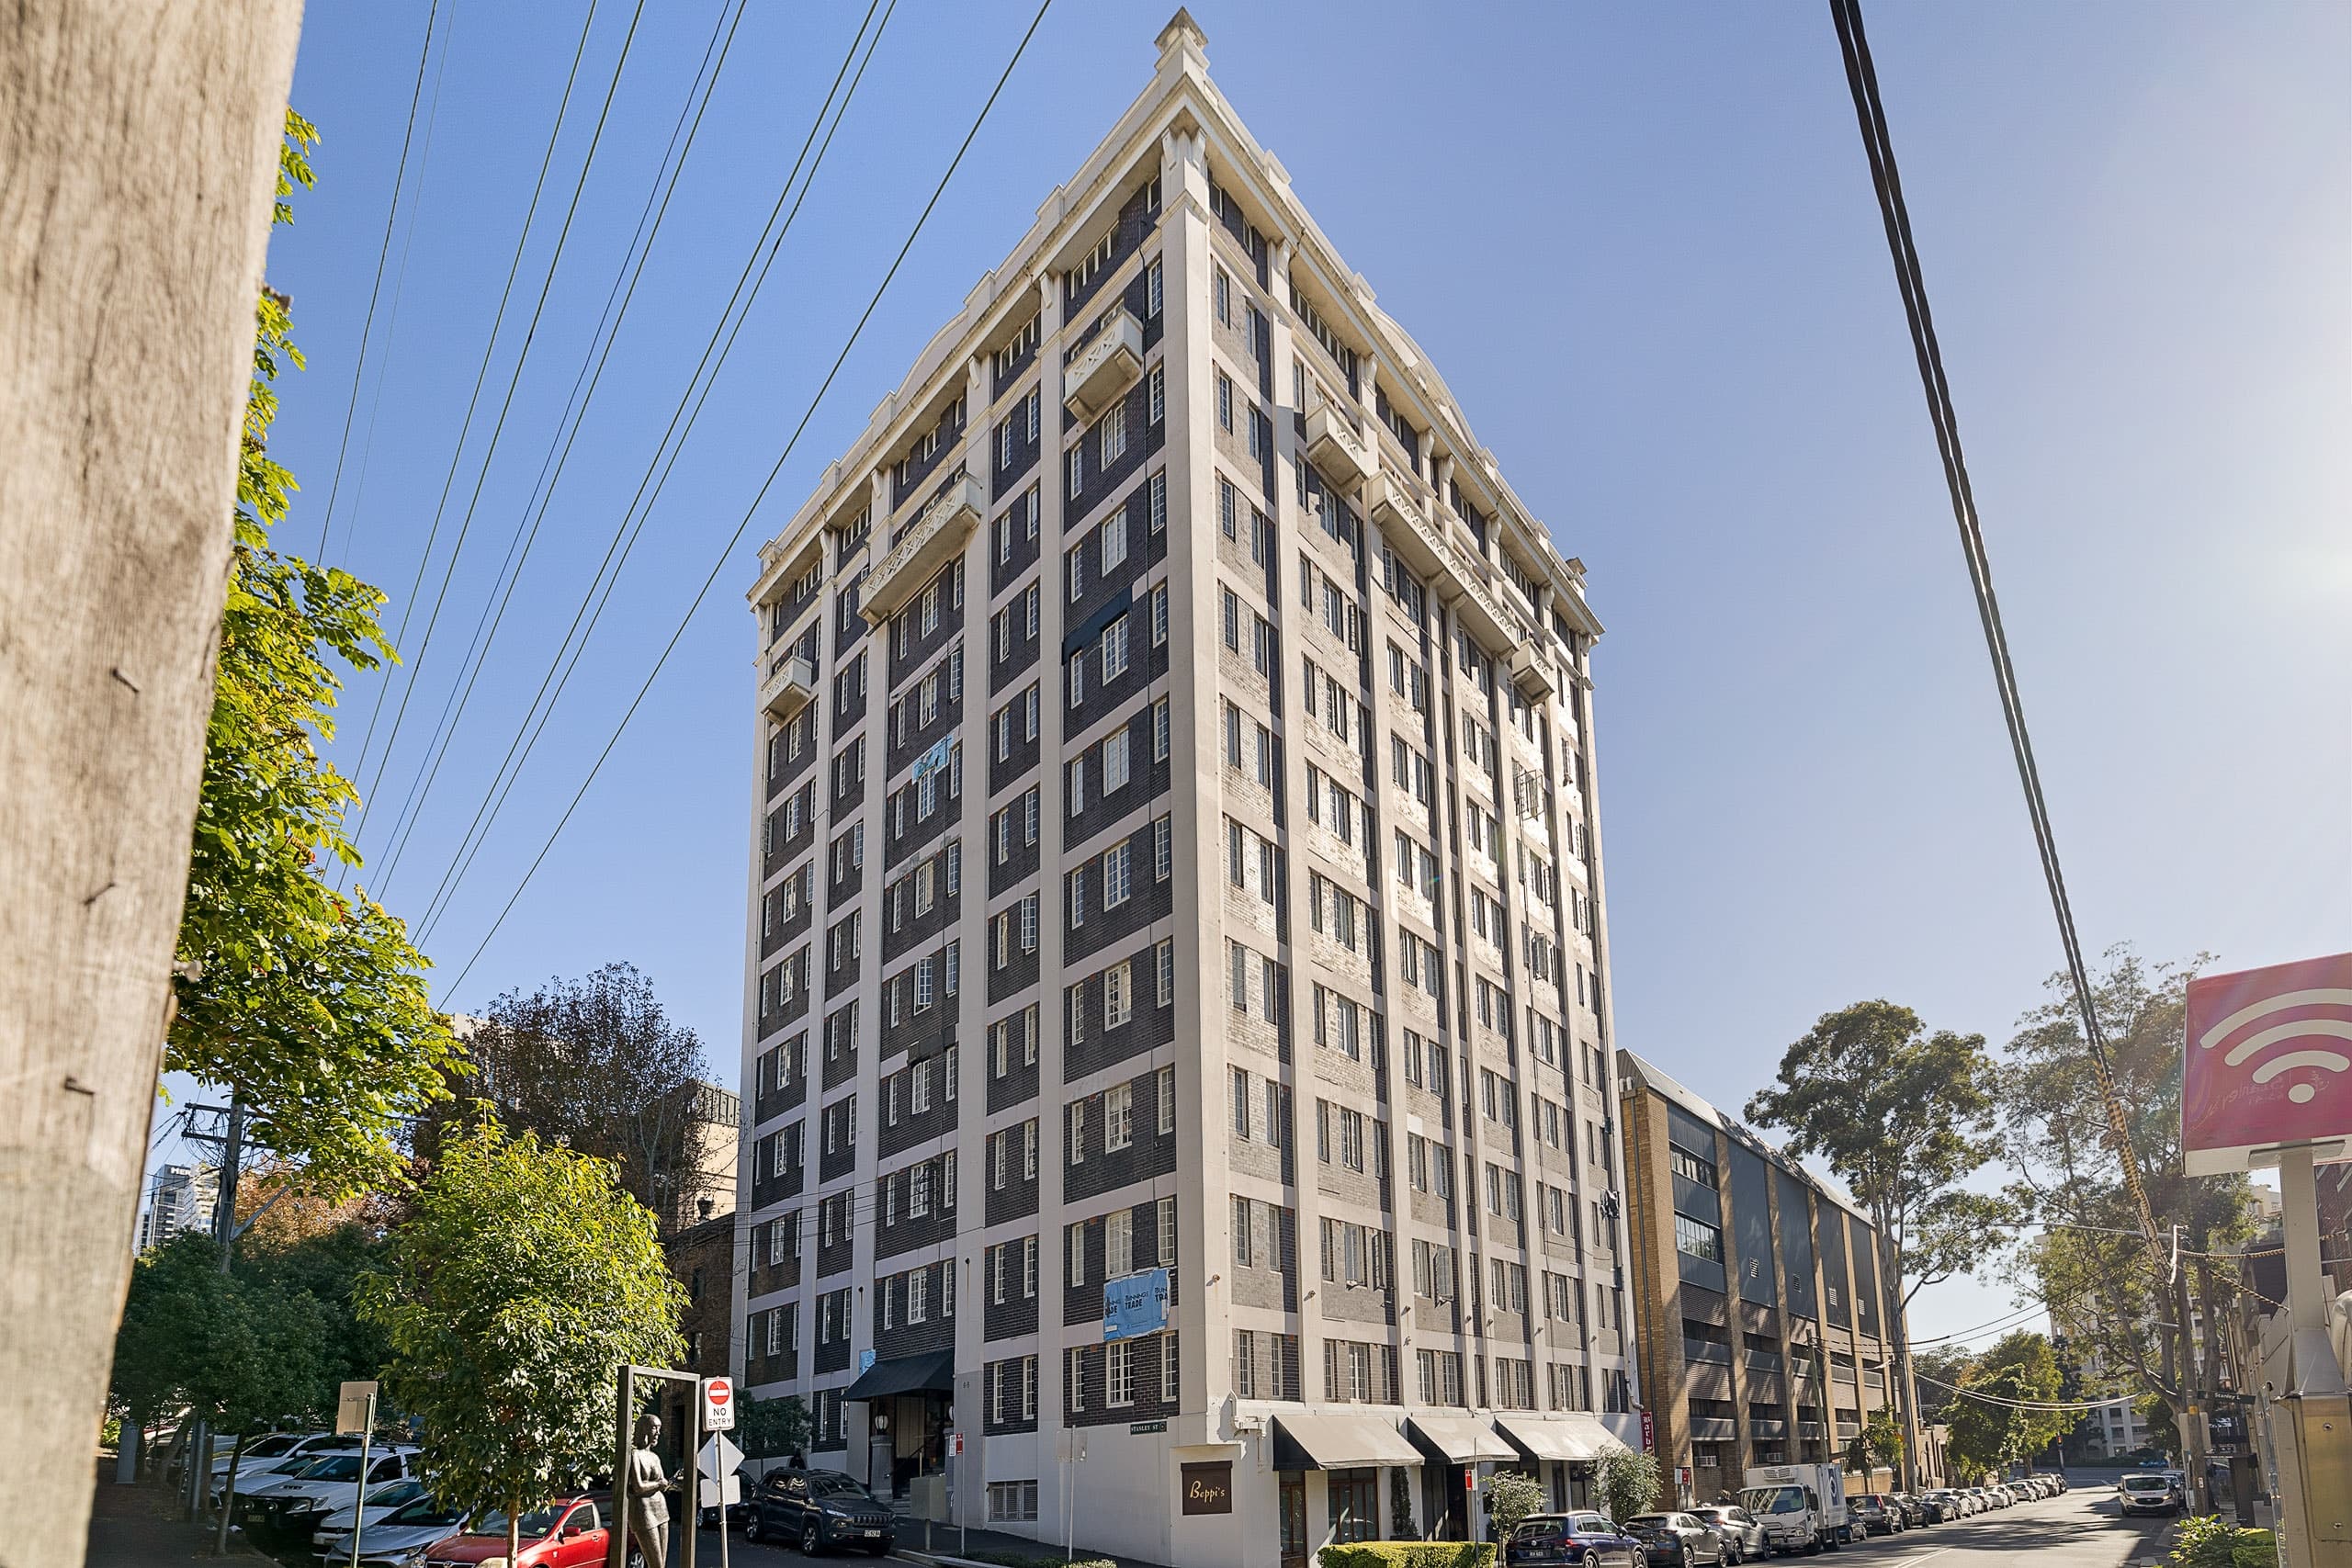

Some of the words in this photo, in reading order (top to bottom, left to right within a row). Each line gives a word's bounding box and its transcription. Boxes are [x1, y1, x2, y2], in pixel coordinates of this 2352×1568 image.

[1125, 1298, 1143, 1310] TRADE
[2214, 1393, 2235, 1401] Stanley
[713, 1407, 727, 1416] NO
[708, 1417, 731, 1426] ENTRY
[1190, 1480, 1226, 1503] Beppi's
